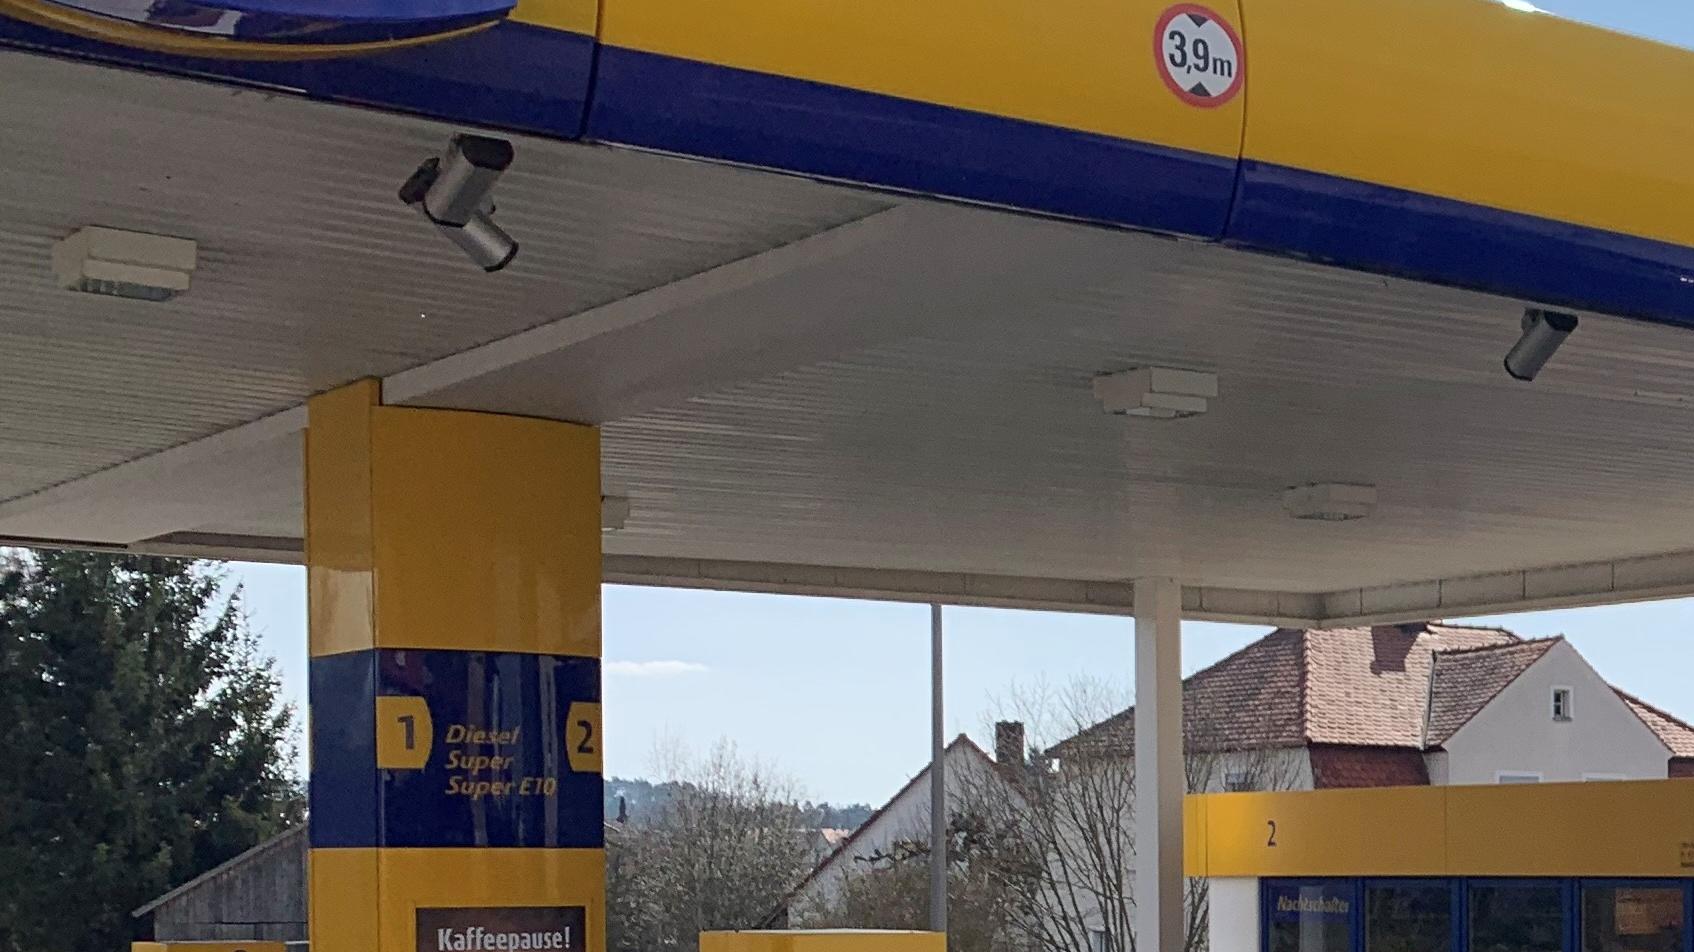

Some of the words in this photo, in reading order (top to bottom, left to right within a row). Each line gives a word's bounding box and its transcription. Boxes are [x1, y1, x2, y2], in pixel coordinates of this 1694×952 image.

[397, 715, 415, 750] 1
[445, 724, 520, 744] Diesel
[576, 720, 594, 754] 2
[445, 750, 514, 772] Super
[445, 776, 517, 799] Super
[519, 777, 557, 796] E10
[1267, 820, 1277, 847] 2
